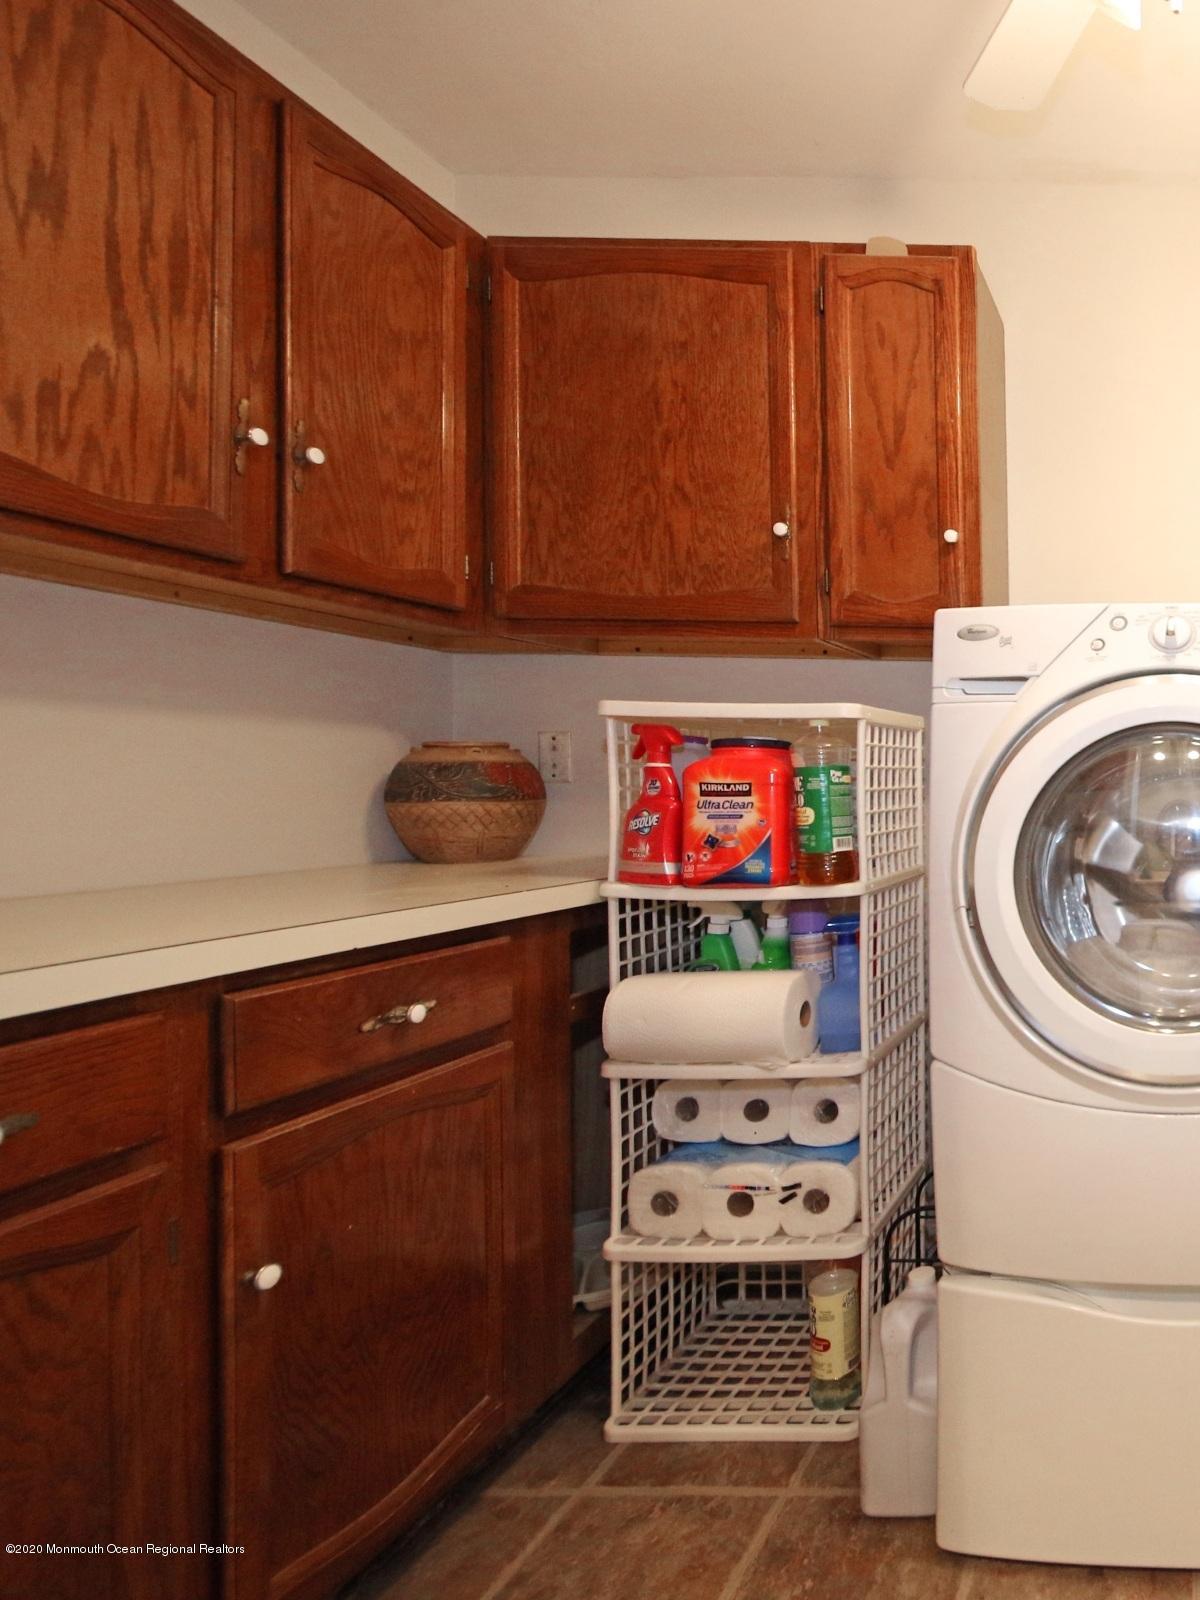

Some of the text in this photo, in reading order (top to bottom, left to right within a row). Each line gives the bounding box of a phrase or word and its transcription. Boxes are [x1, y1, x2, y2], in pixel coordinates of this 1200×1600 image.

[701, 783, 750, 792] KIRKLAND
[696, 800, 754, 810] Ultra Clean
[627, 813, 660, 832] RESOLVE
